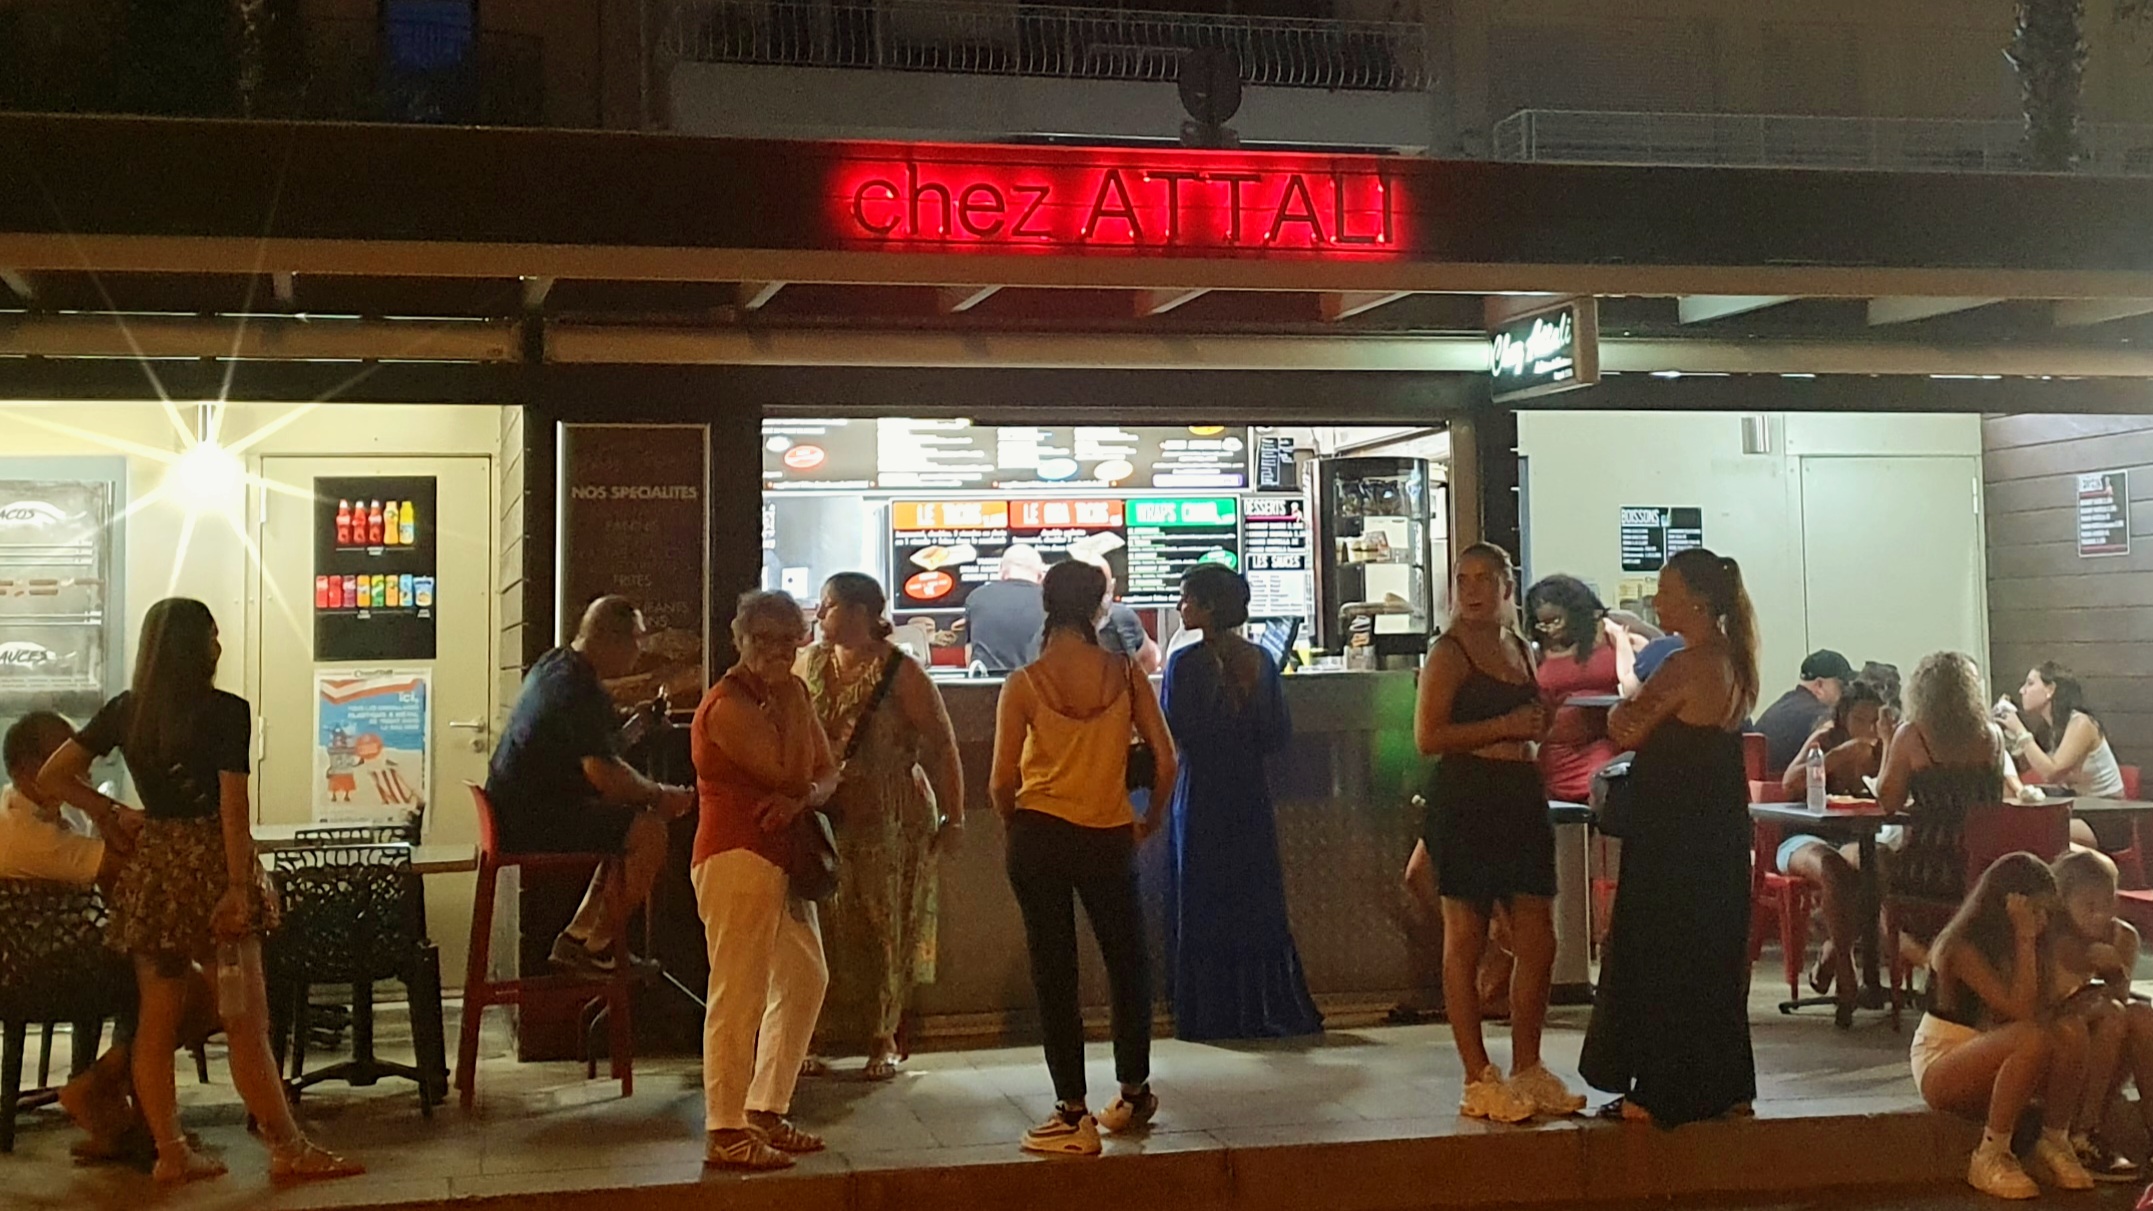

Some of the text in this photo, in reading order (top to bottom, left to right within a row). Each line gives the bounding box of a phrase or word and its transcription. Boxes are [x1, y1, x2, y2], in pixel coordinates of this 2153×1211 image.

[852, 163, 1393, 244] chez ATTALI
[571, 485, 698, 500] NOS SPECIALITES
[917, 503, 936, 526] LE
[1023, 502, 1040, 525] LE
[1136, 503, 1177, 523] WRAPS
